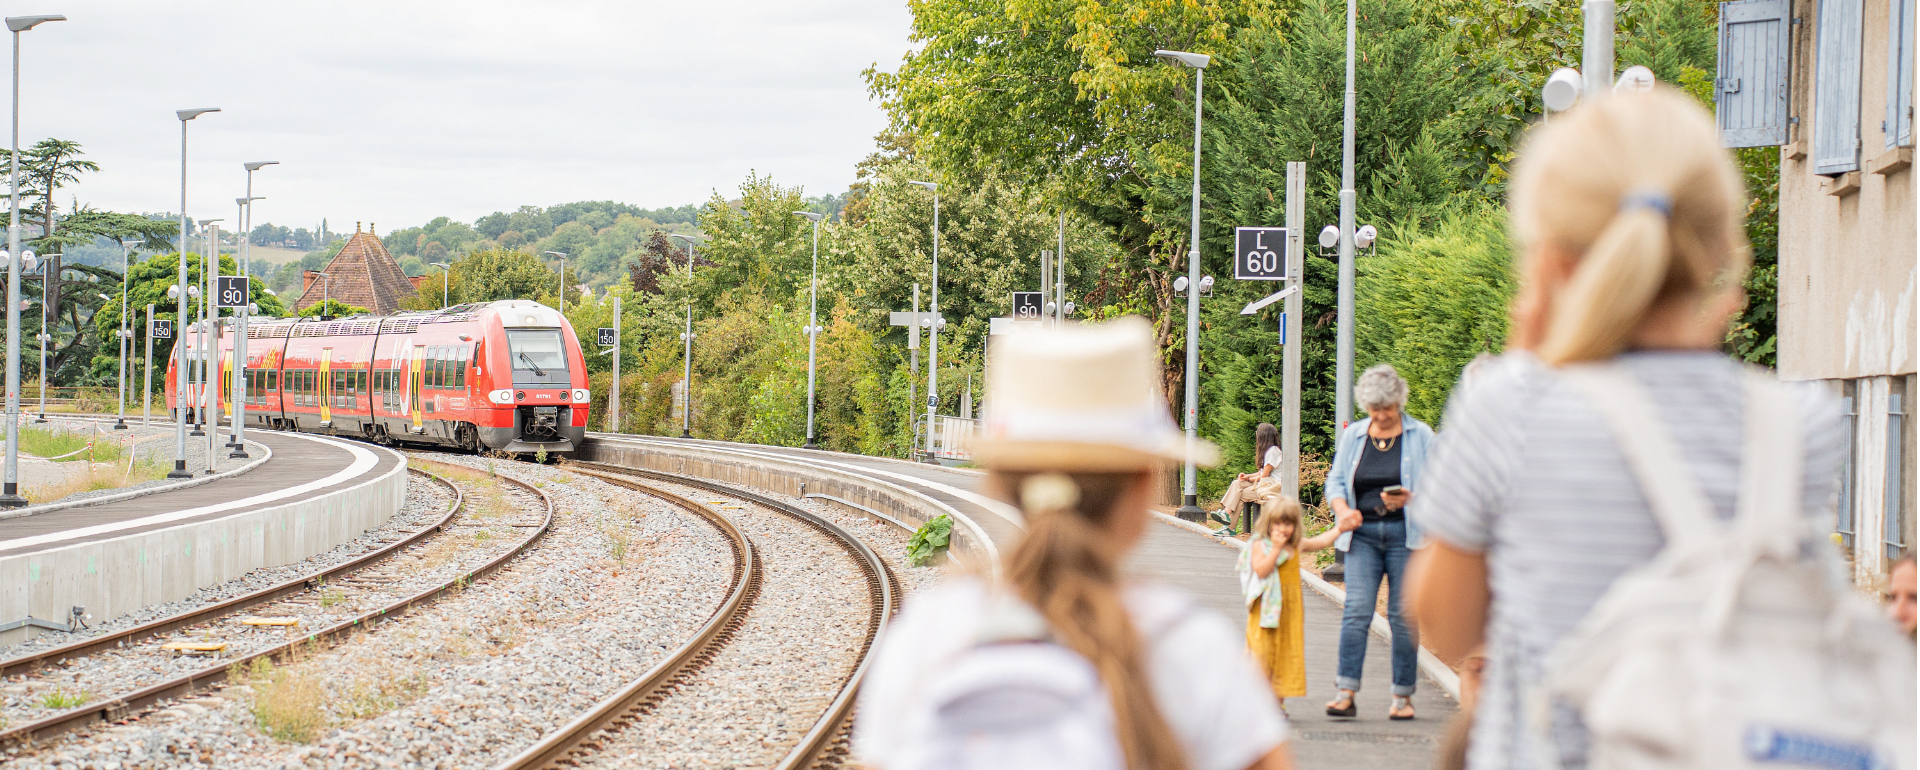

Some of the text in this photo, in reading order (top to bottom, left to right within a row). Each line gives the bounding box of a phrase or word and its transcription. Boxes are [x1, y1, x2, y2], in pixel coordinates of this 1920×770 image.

[1256, 232, 1268, 250] L
[1247, 250, 1277, 273] 60
[228, 278, 237, 290] L
[223, 289, 242, 304] 90
[1024, 294, 1032, 306] L
[1019, 305, 1037, 319] 90
[154, 327, 169, 336] 150
[600, 335, 614, 344] 150
